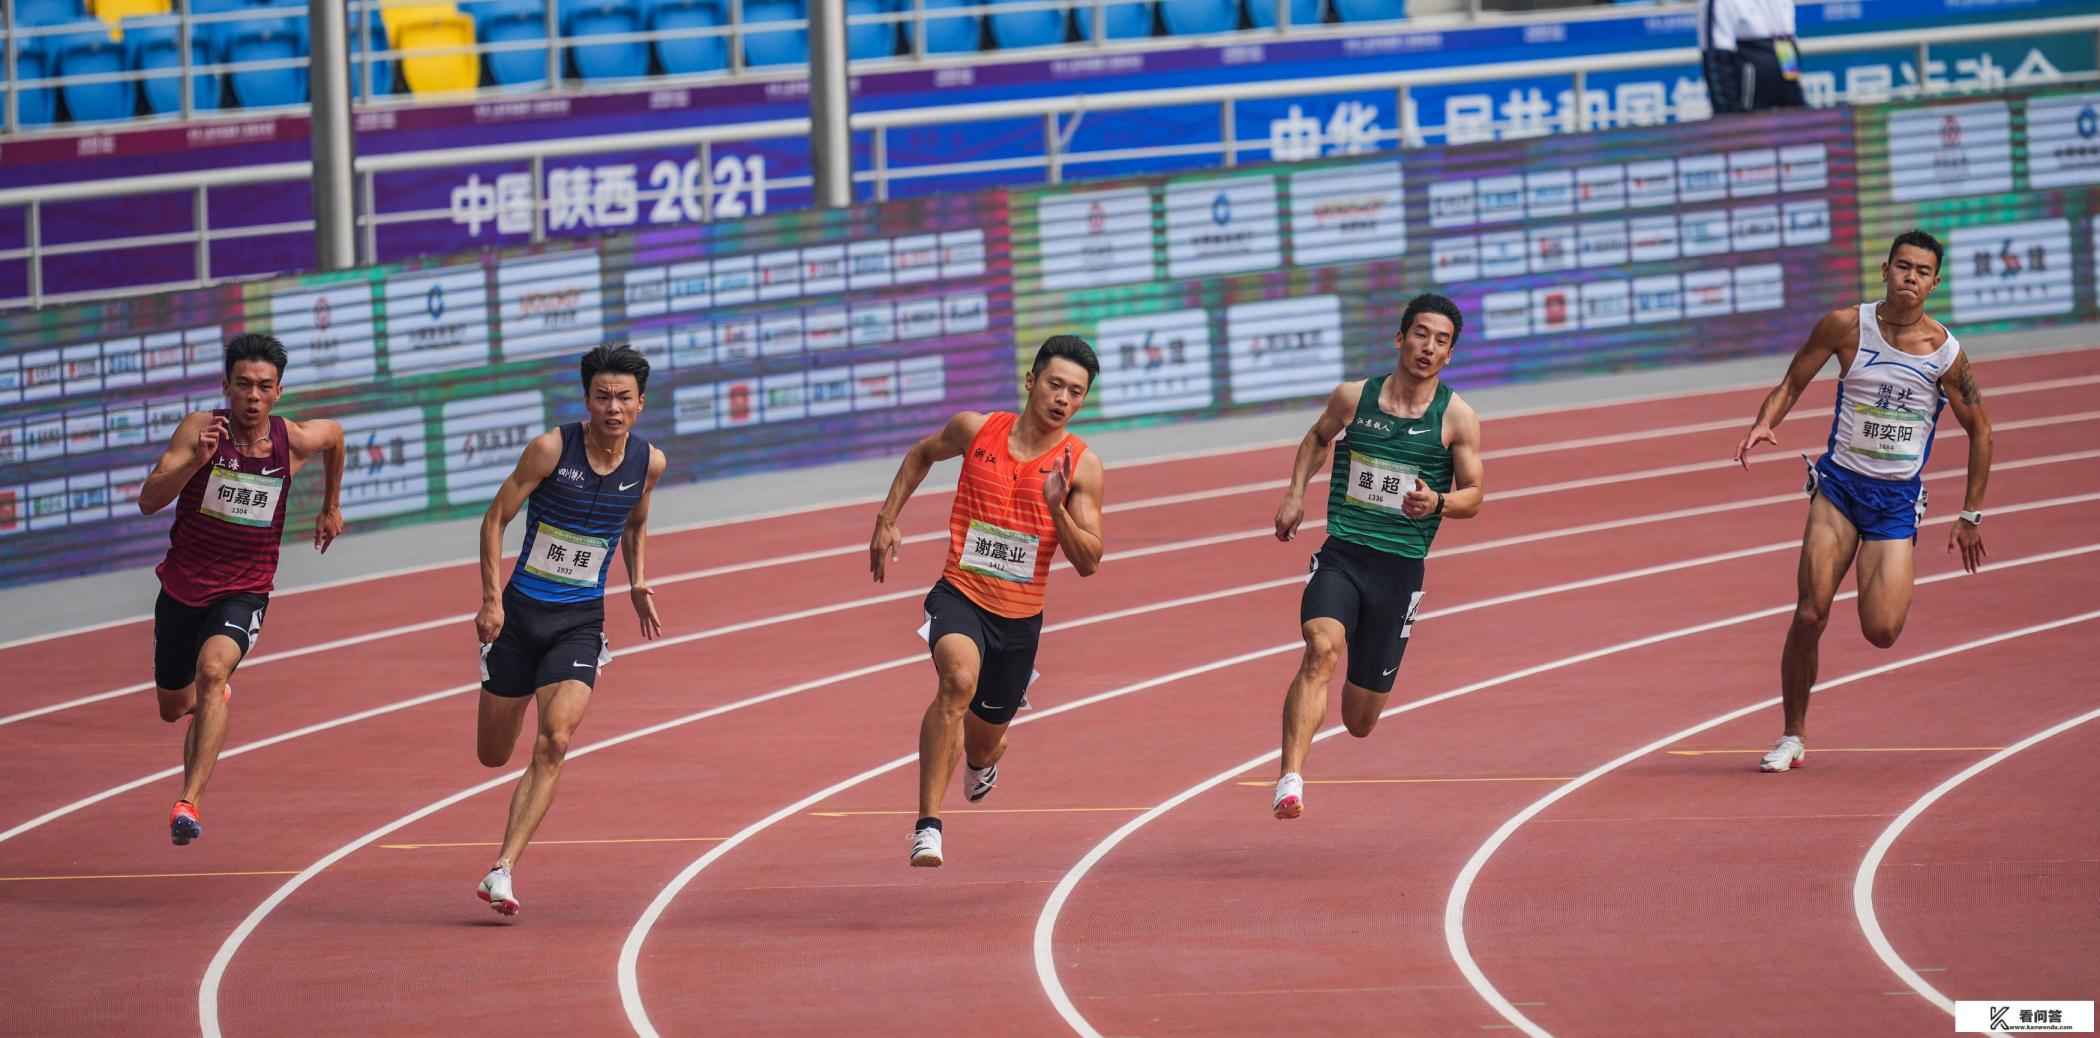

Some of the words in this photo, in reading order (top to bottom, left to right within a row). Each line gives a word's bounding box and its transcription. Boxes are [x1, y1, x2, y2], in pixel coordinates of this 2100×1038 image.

[649, 155, 767, 223] 2021
[1862, 420, 1914, 443] 郭奕阳
[214, 455, 240, 471] 上海
[218, 484, 269, 508] 何嘉勇
[974, 536, 1027, 564] 谢震业
[556, 566, 573, 575] 1932
